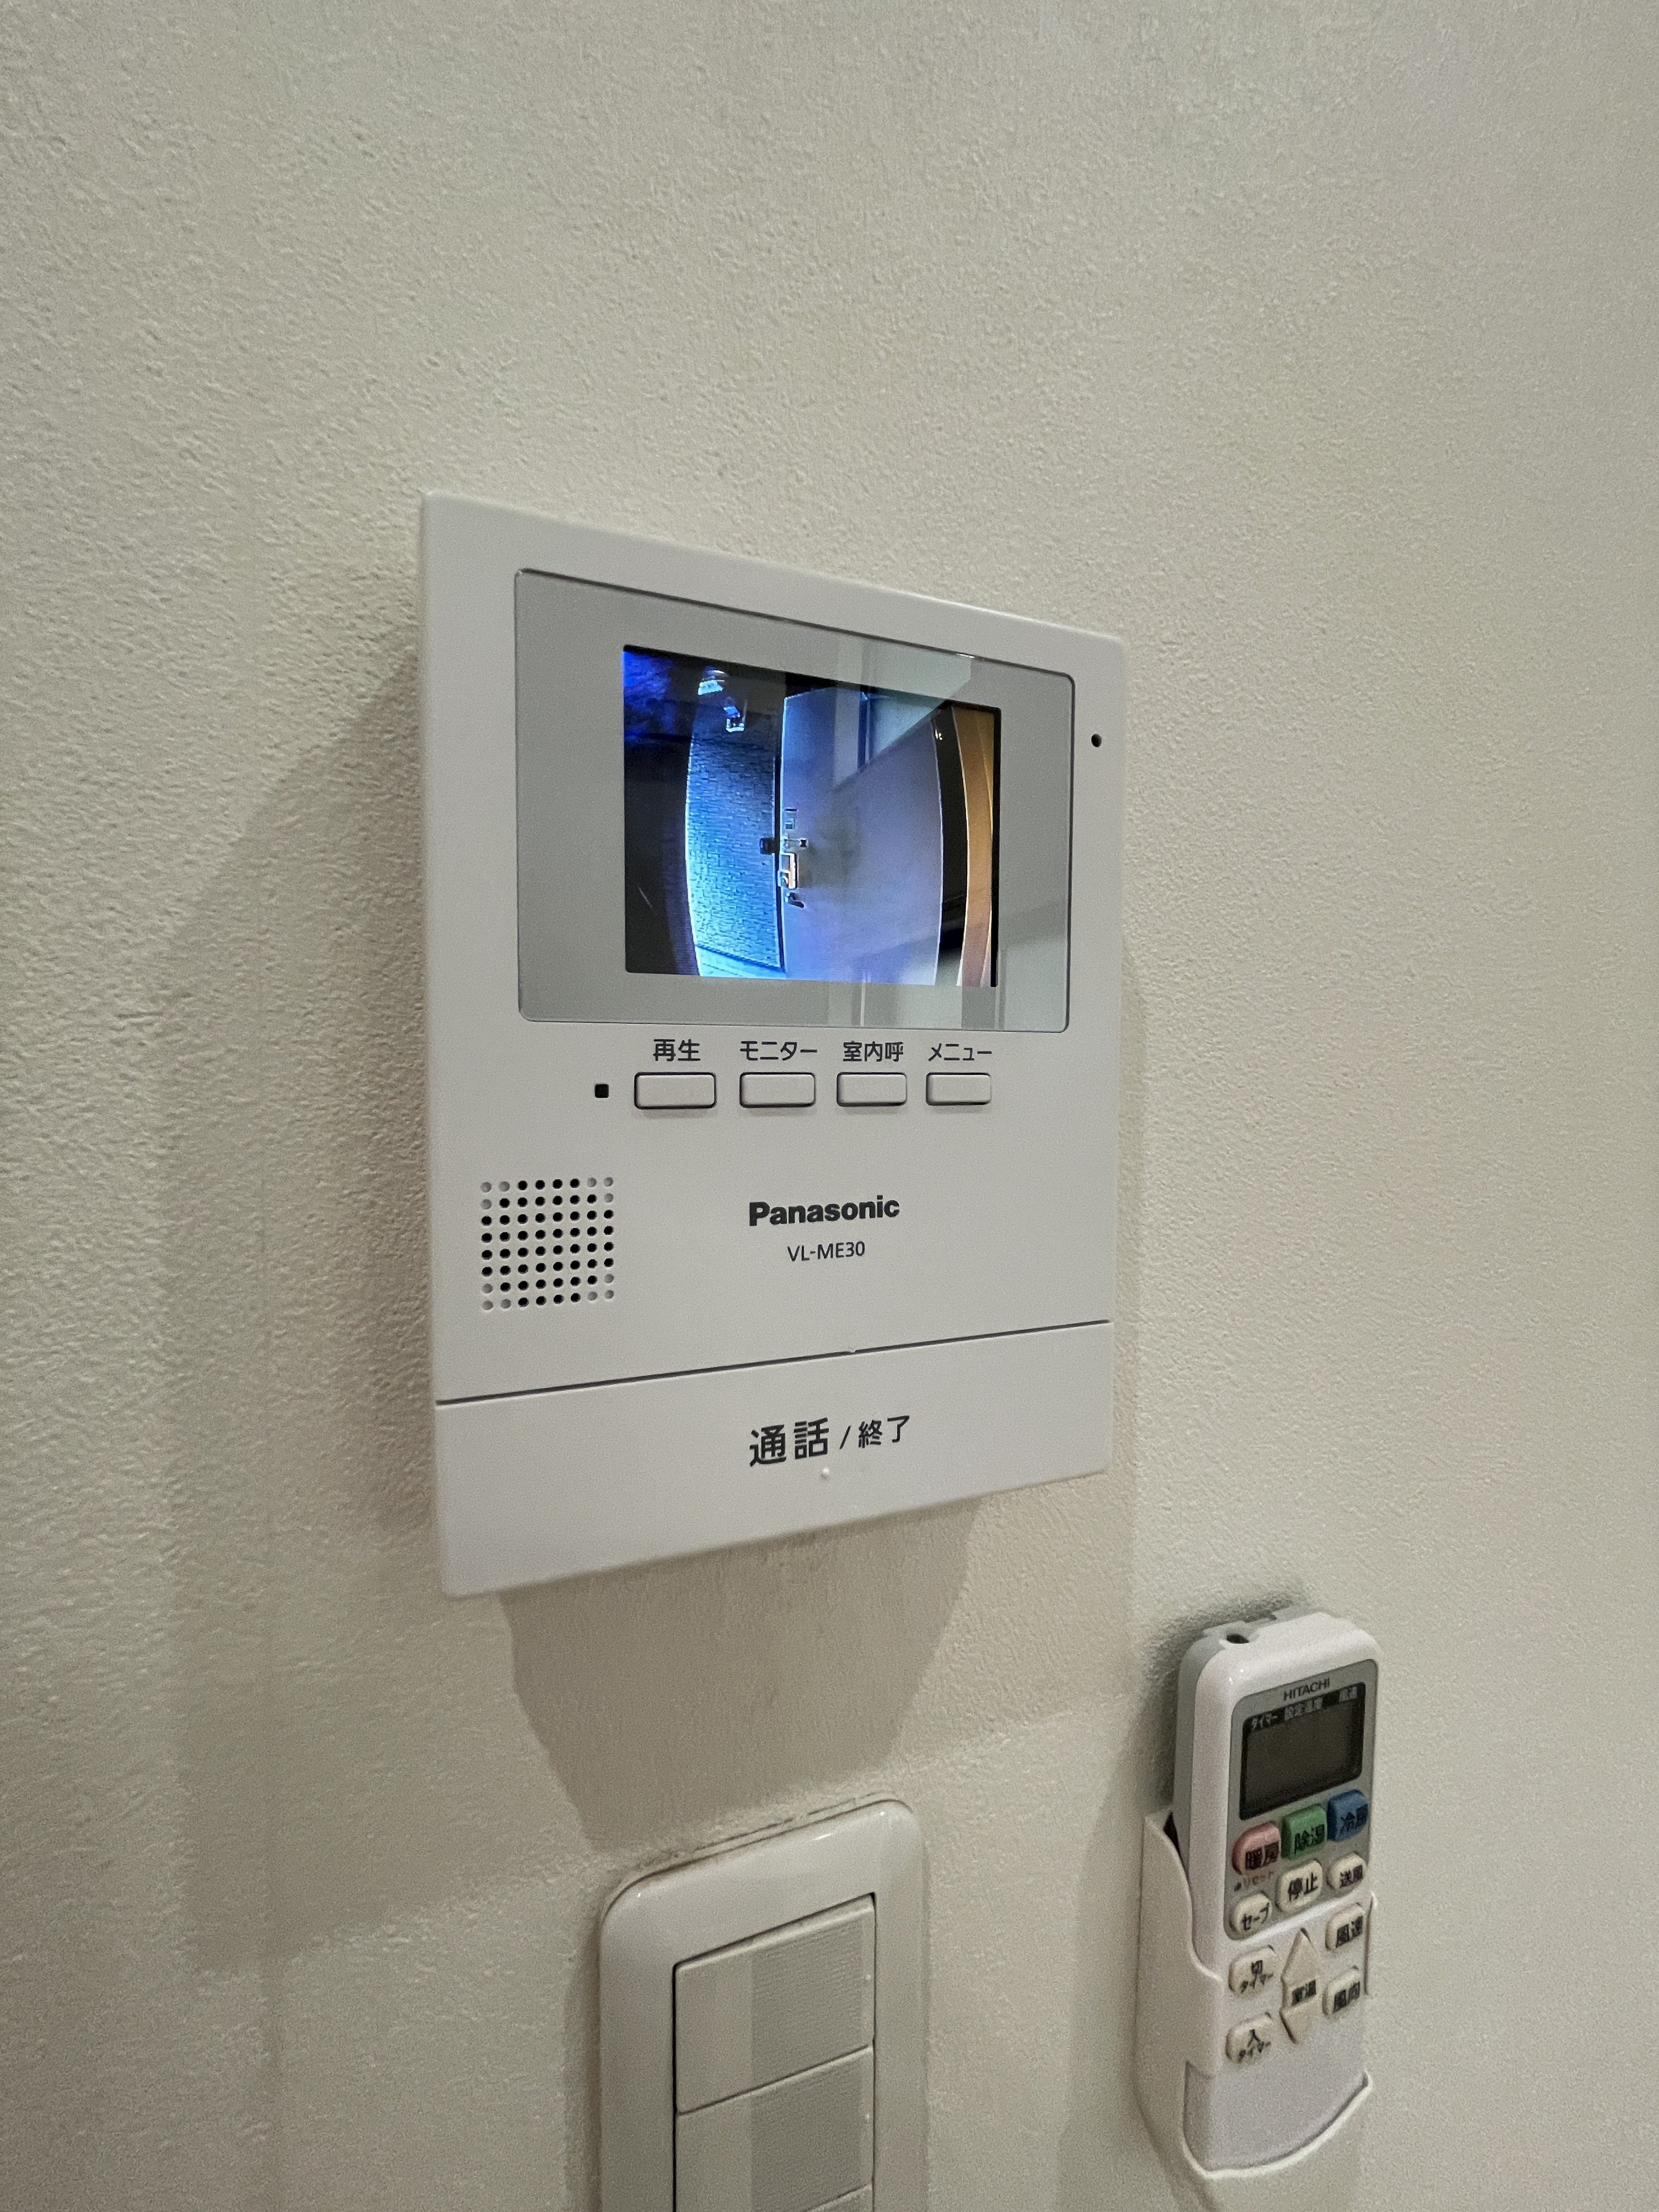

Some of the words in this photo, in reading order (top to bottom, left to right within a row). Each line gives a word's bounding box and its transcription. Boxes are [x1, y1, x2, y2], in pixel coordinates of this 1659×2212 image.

[653, 1039, 701, 1062] 再生
[740, 1040, 818, 1062] モニター
[843, 1041, 904, 1063] 室内呼
[928, 1043, 992, 1062] メニュー
[749, 1195, 900, 1227] Panasonic
[787, 1241, 866, 1262] VL-ME30
[1283, 1677, 1330, 1701] HITACHI
[1251, 1713, 1278, 1730] タイマー
[1294, 1823, 1325, 1856] 除湿
[1245, 1841, 1279, 1871] 暖房
[1288, 1871, 1319, 1902] 停止
